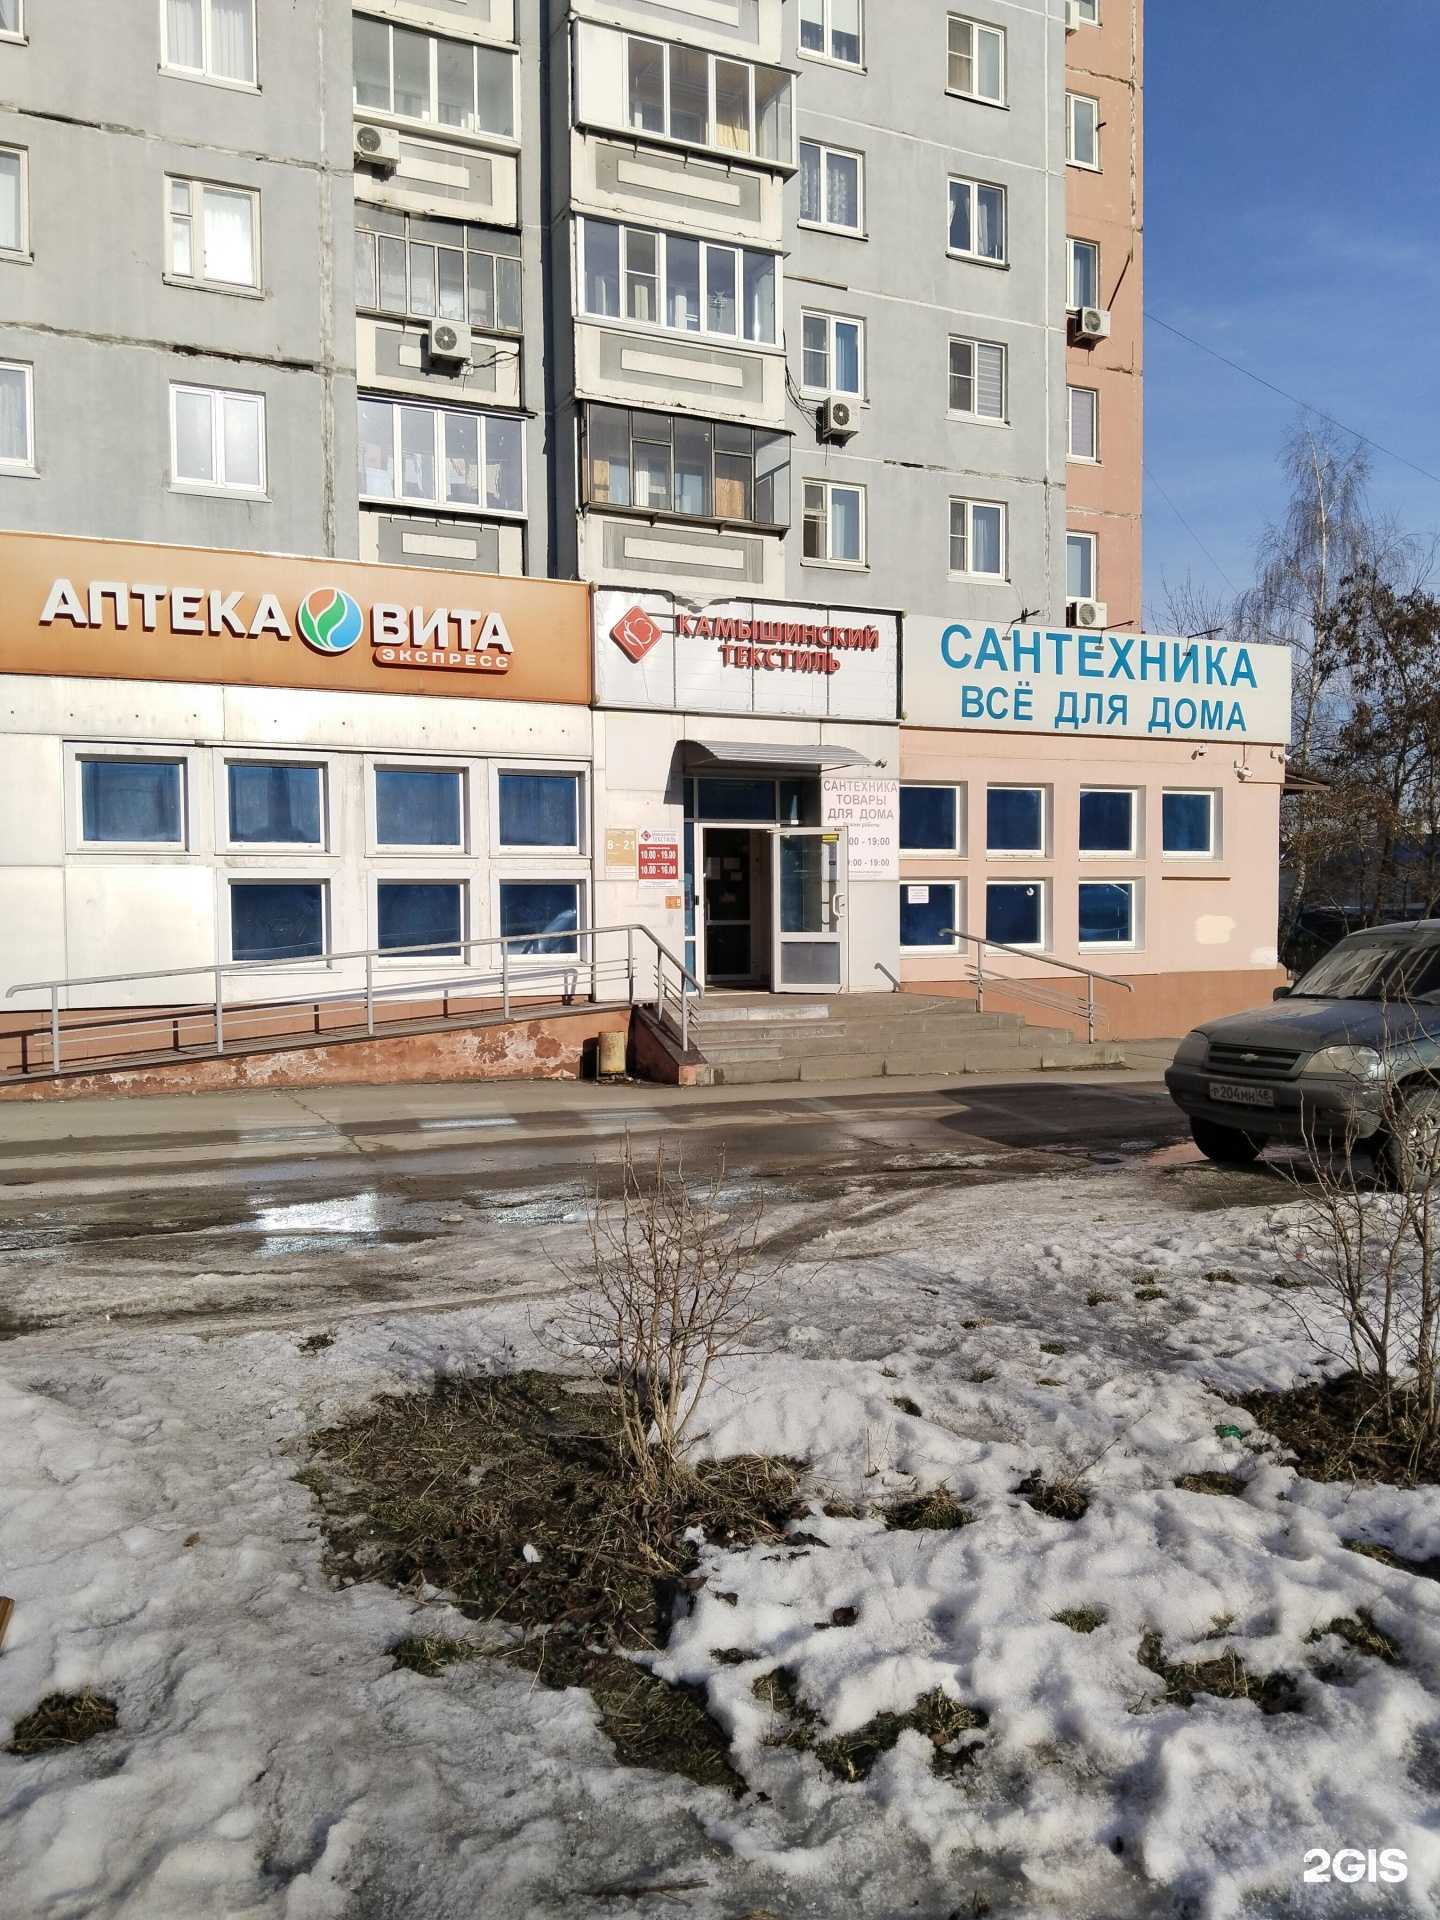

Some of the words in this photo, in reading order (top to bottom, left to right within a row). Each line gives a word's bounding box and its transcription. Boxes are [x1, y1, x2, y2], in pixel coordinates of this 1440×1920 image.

[39, 578, 292, 641] АПТЕКА
[371, 602, 513, 652] ВИТА
[677, 614, 880, 650] КАМЫШИНСКИЙ
[381, 648, 509, 668] ЭКСПРЕСС
[720, 644, 841, 673] ТЕКСТИЛЬ
[941, 624, 1258, 689] САНТЕХНИКА
[961, 681, 1033, 721] ВСЁ
[1055, 691, 1128, 729] ДЛЯ
[1148, 697, 1247, 733] ДОМА
[823, 780, 898, 793] САНТЕХНИКА
[836, 794, 887, 806] ТОВАРЫ
[828, 808, 853, 820] ДЛЯ
[859, 808, 894, 820] ДОМА
